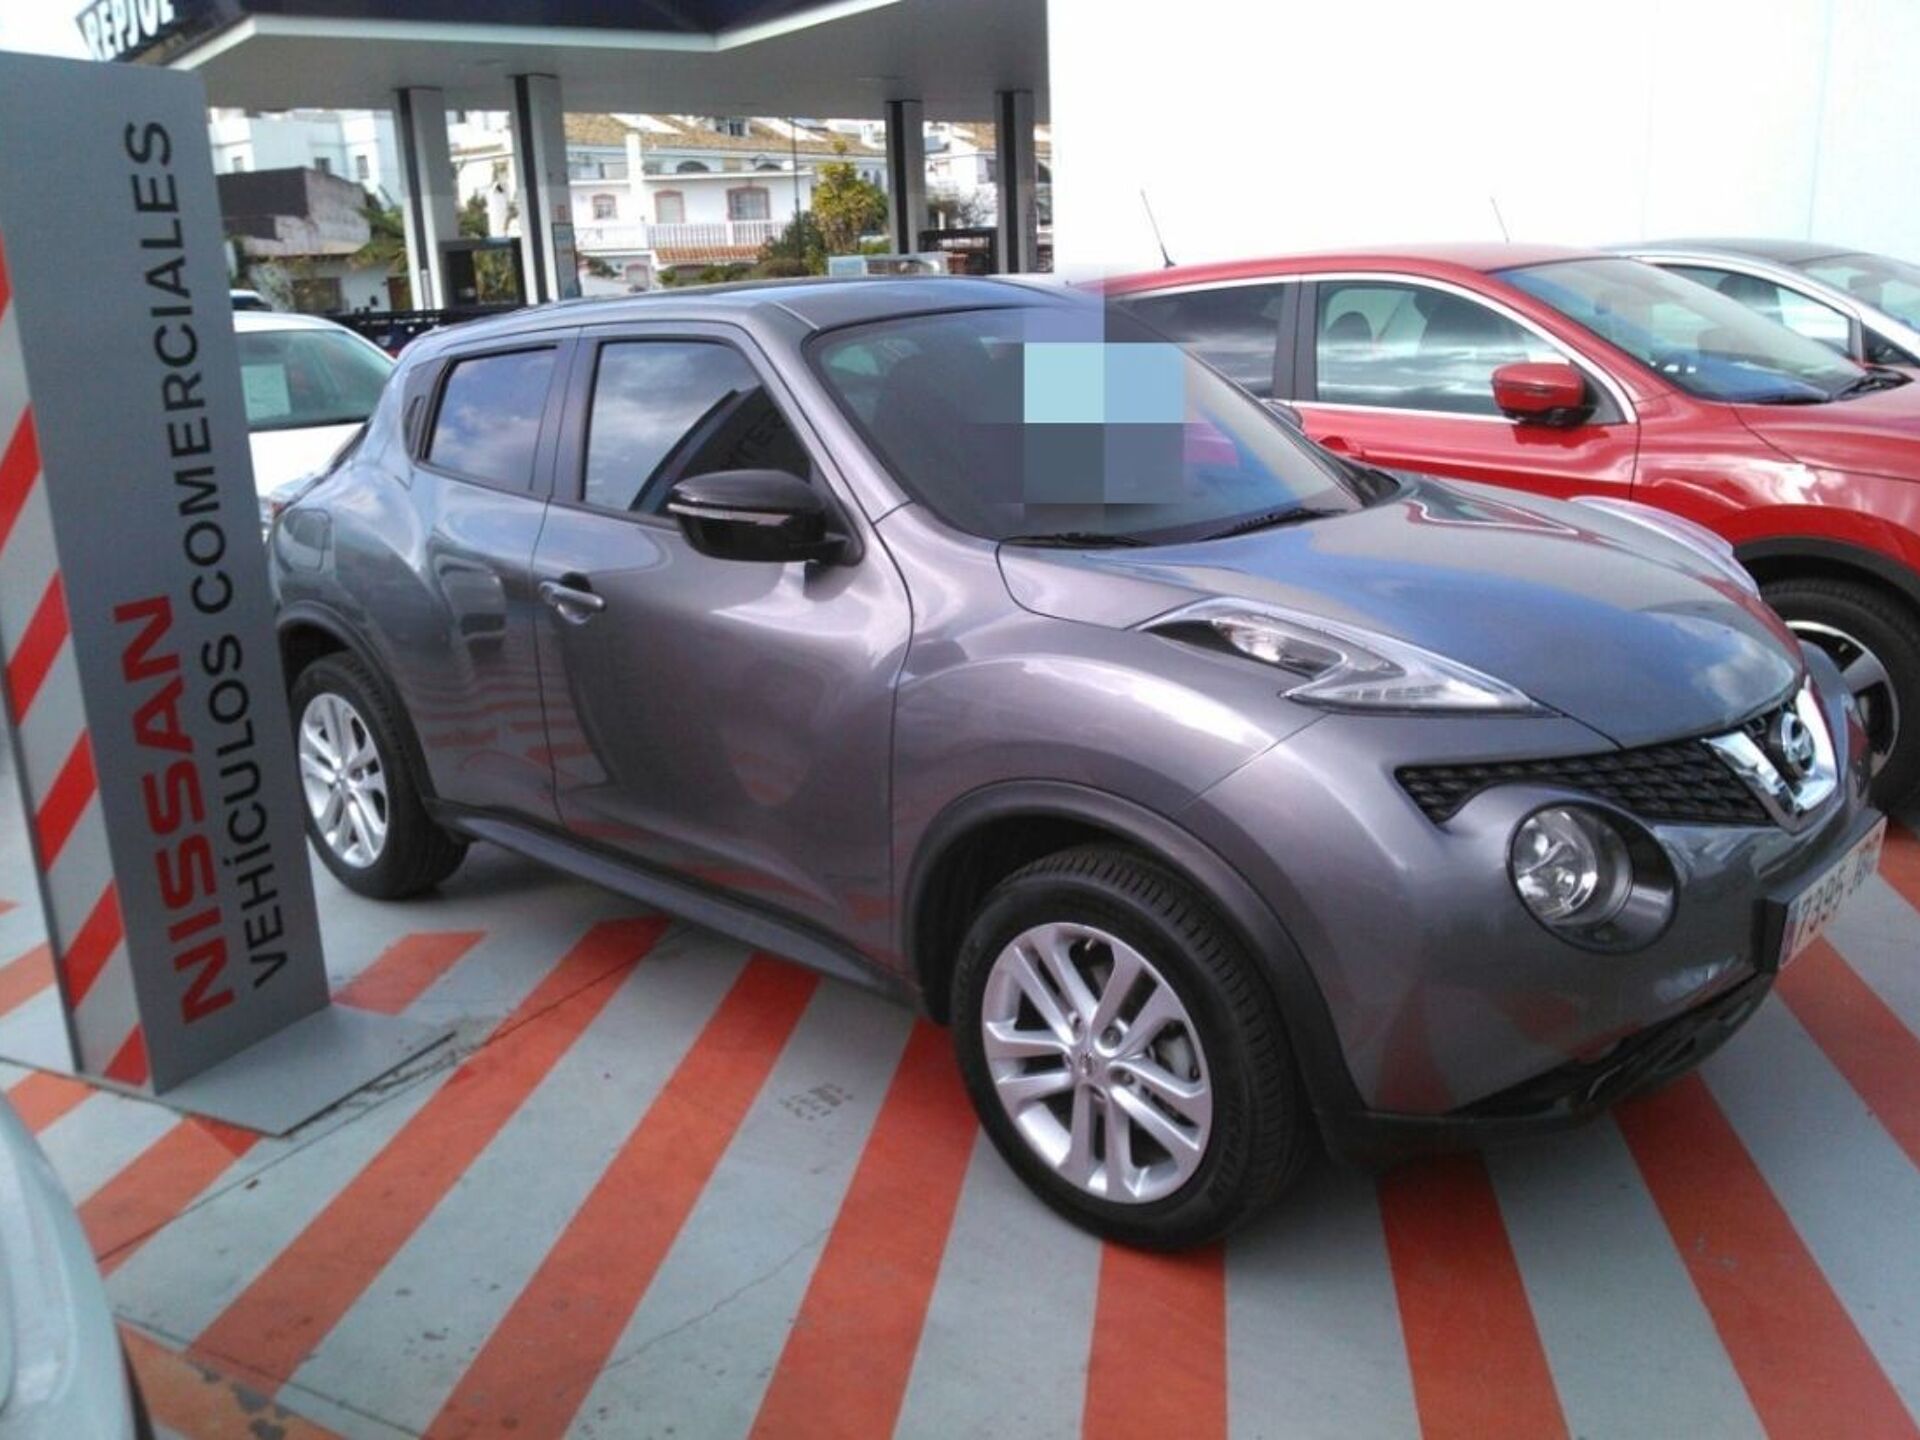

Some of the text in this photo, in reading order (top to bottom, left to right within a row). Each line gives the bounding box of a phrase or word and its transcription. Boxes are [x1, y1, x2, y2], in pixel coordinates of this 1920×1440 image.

[114, 597, 234, 1023] NISSAN
[125, 122, 288, 989] VEHÍCULOS COMERCIALES
